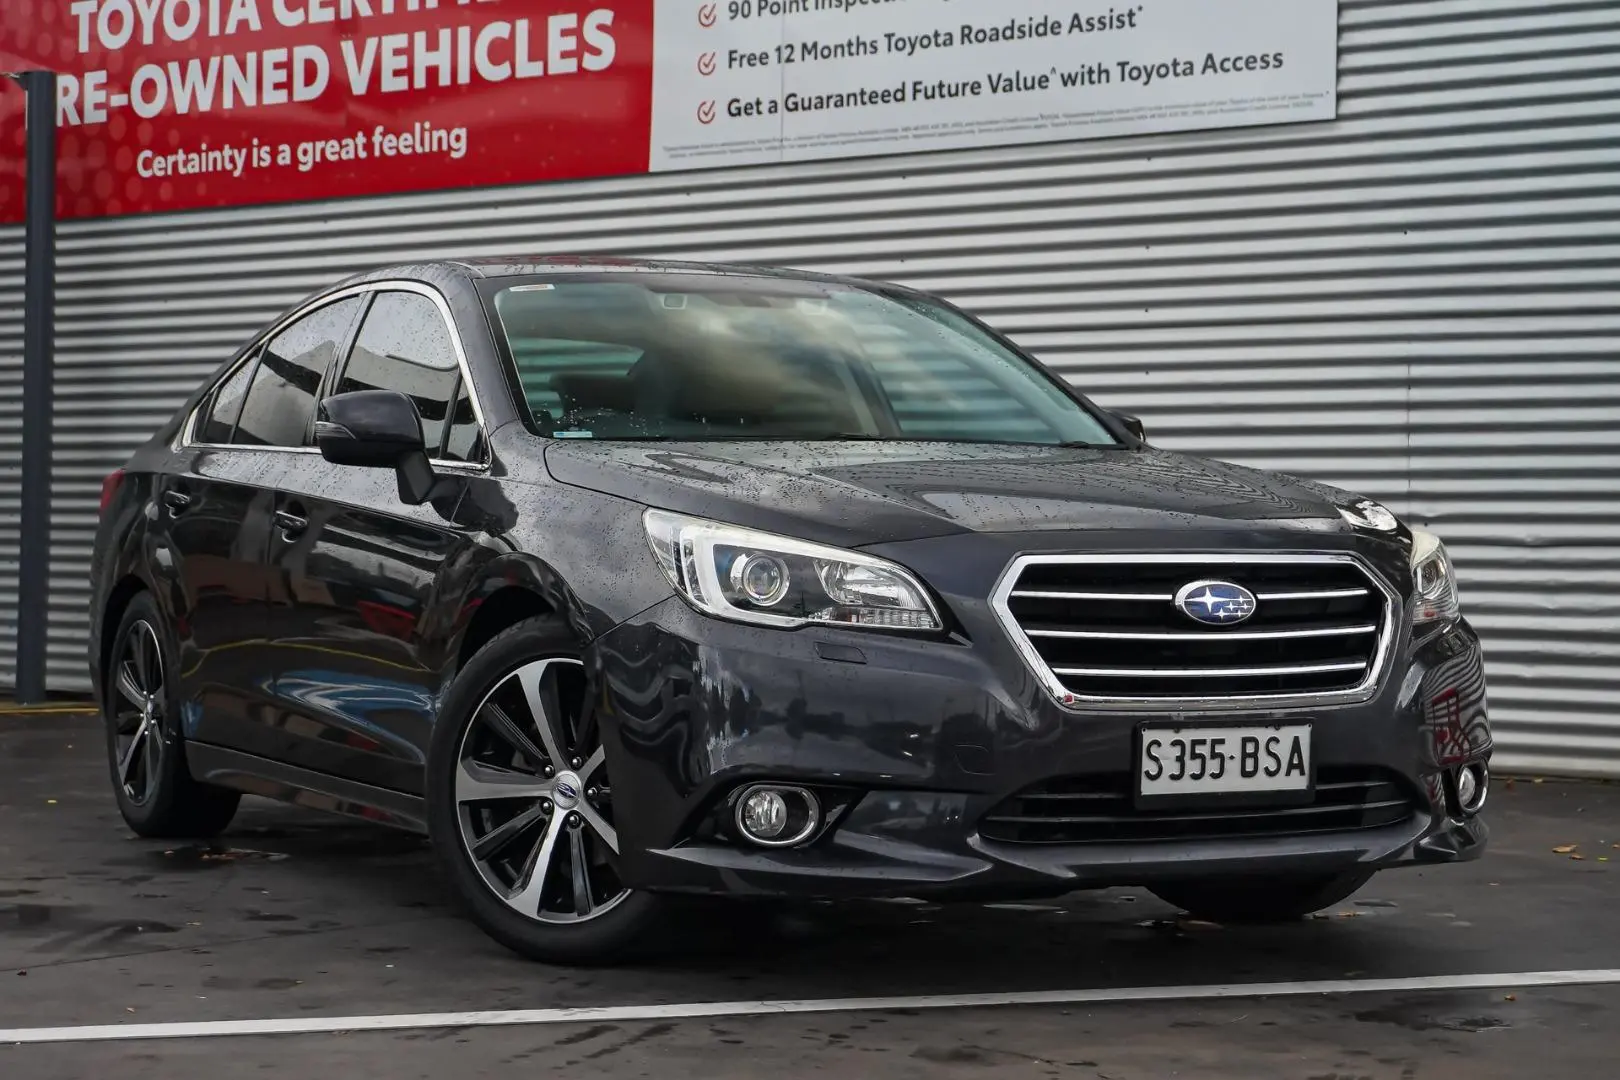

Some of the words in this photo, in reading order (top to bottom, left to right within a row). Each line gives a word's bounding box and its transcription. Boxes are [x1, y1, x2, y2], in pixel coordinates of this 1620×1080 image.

[71, 0, 262, 53] TOYOTA
[728, 1, 752, 21] 90
[757, 0, 810, 17] Point
[25, 45, 331, 132] RE-OWNED
[341, 8, 617, 96] VEHICLES
[728, 50, 769, 70] Free
[775, 43, 796, 64] 12
[801, 36, 879, 62] Months
[884, 29, 954, 56] Toyota
[960, 15, 1062, 45] Roadside
[727, 97, 763, 118] Get
[768, 99, 779, 114] a
[784, 81, 906, 113] Guaranteed
[912, 80, 983, 101] Future
[1060, 62, 1111, 88] with
[1116, 57, 1195, 86] Toyota
[1201, 50, 1284, 76] Access
[136, 143, 246, 178] Certainty
[252, 137, 272, 168] is
[277, 143, 291, 166] a
[297, 130, 368, 172] great
[372, 120, 467, 159] feeling
